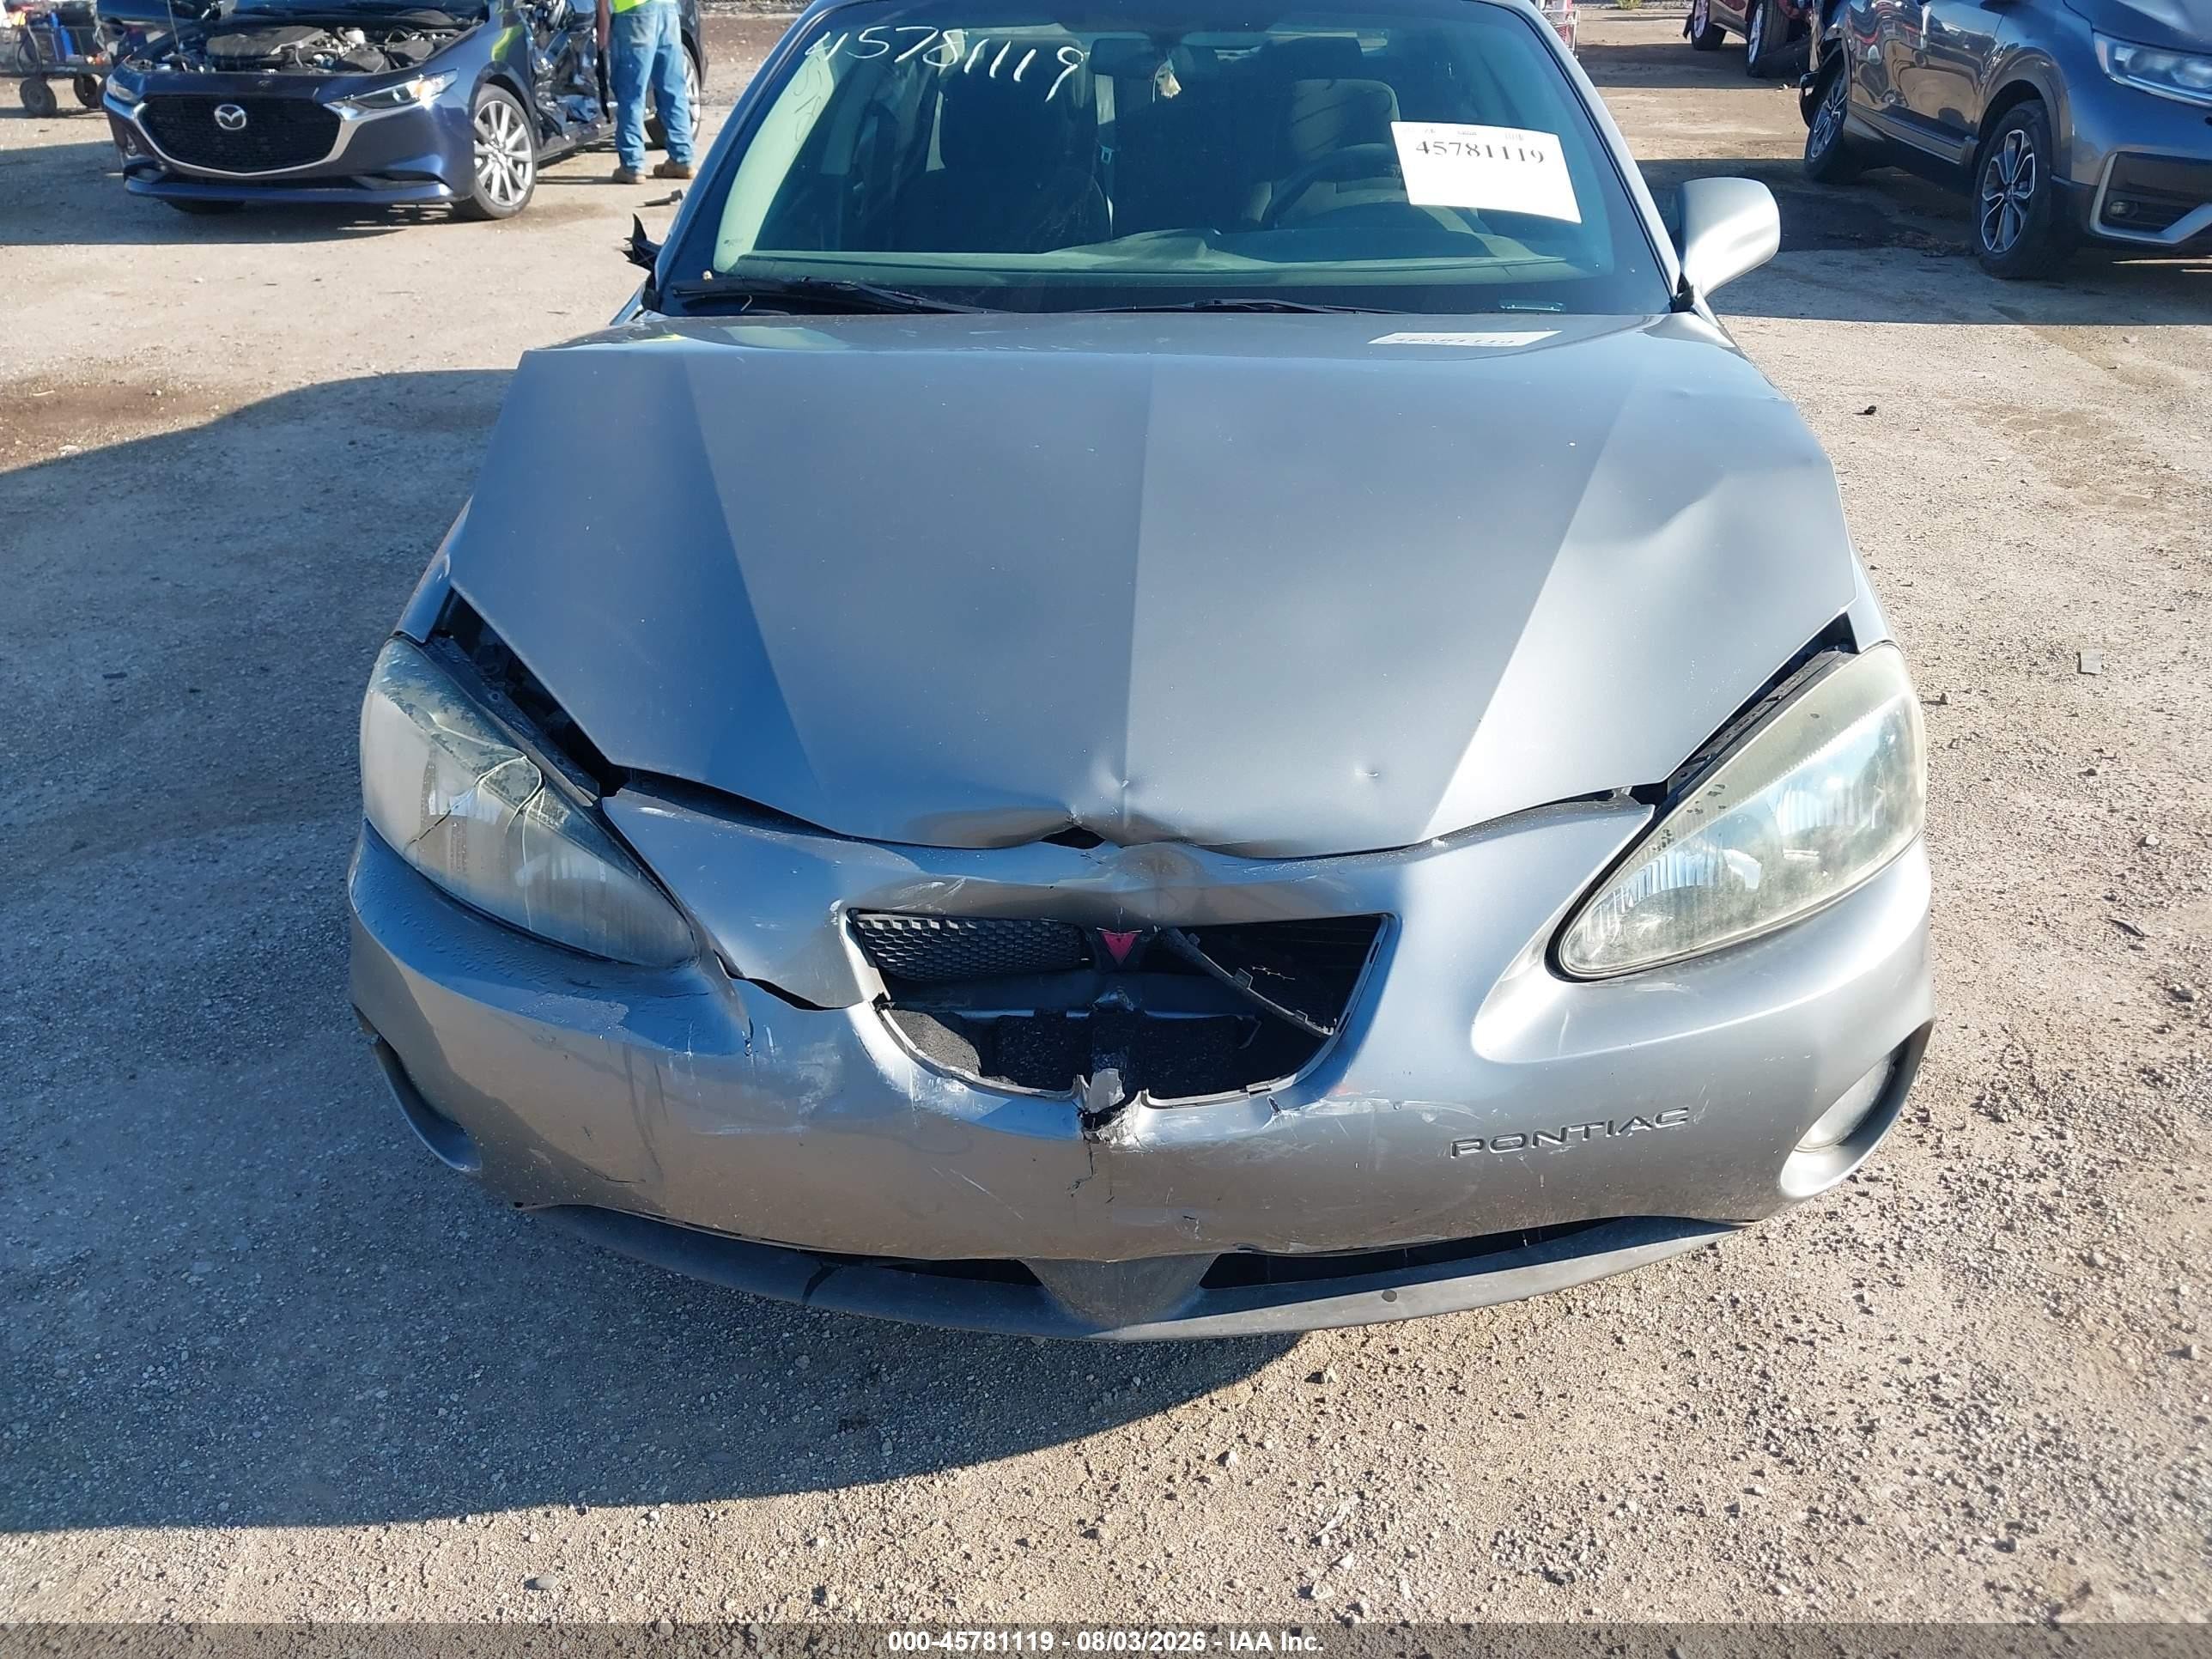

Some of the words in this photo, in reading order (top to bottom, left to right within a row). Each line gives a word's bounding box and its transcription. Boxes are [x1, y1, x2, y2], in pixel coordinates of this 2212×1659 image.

[805, 25, 1091, 102] 45781119
[1415, 140, 1545, 164] 45781119
[1450, 1106, 1689, 1159] PONTIAC
